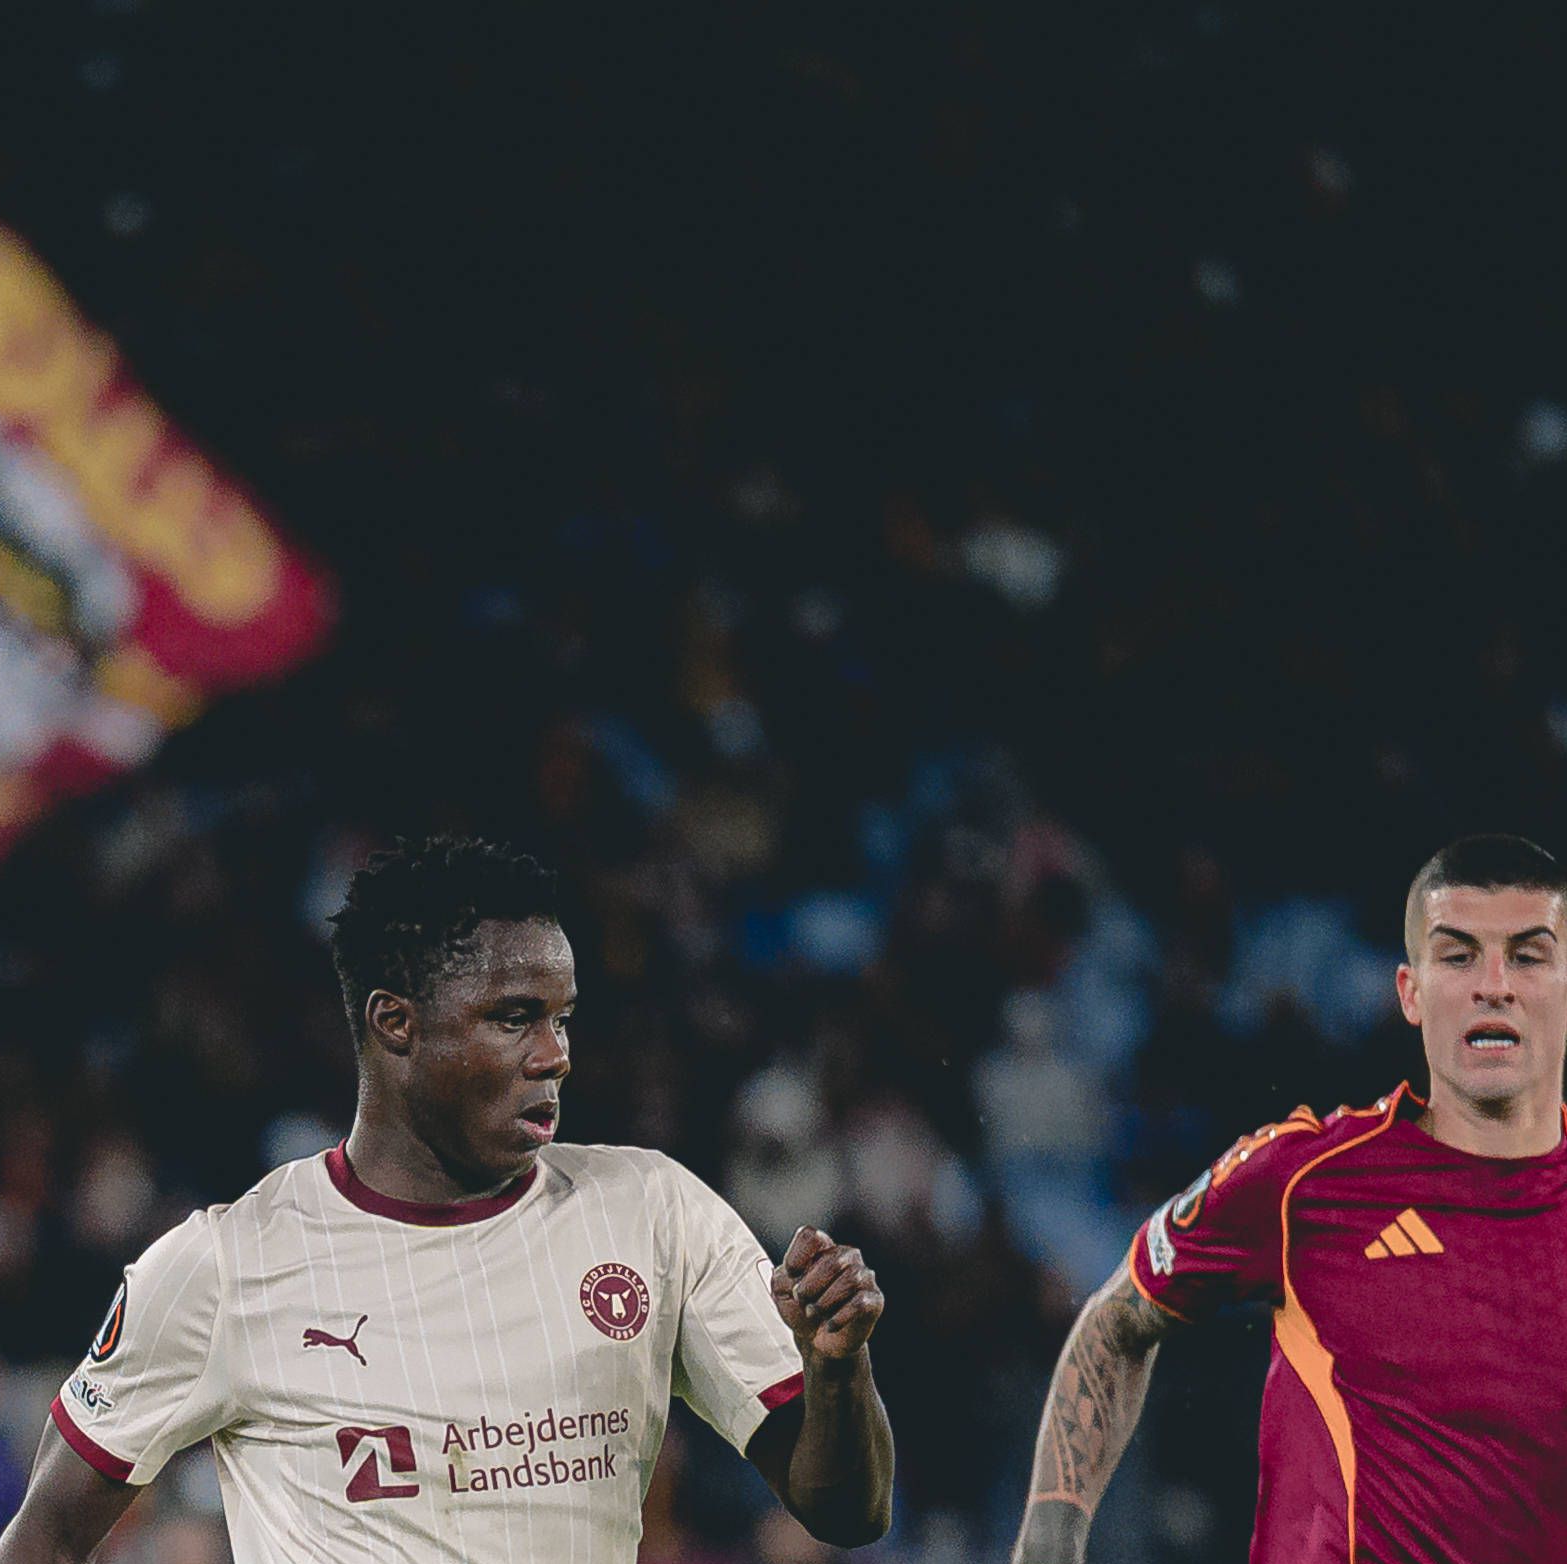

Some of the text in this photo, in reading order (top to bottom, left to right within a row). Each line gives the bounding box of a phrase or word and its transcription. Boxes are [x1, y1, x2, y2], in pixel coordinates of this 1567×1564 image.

[582, 1265, 649, 1318] FC MIDTJYLLAND
[441, 1406, 630, 1455] Arbejdernes
[447, 1443, 617, 1494] Landsbank
